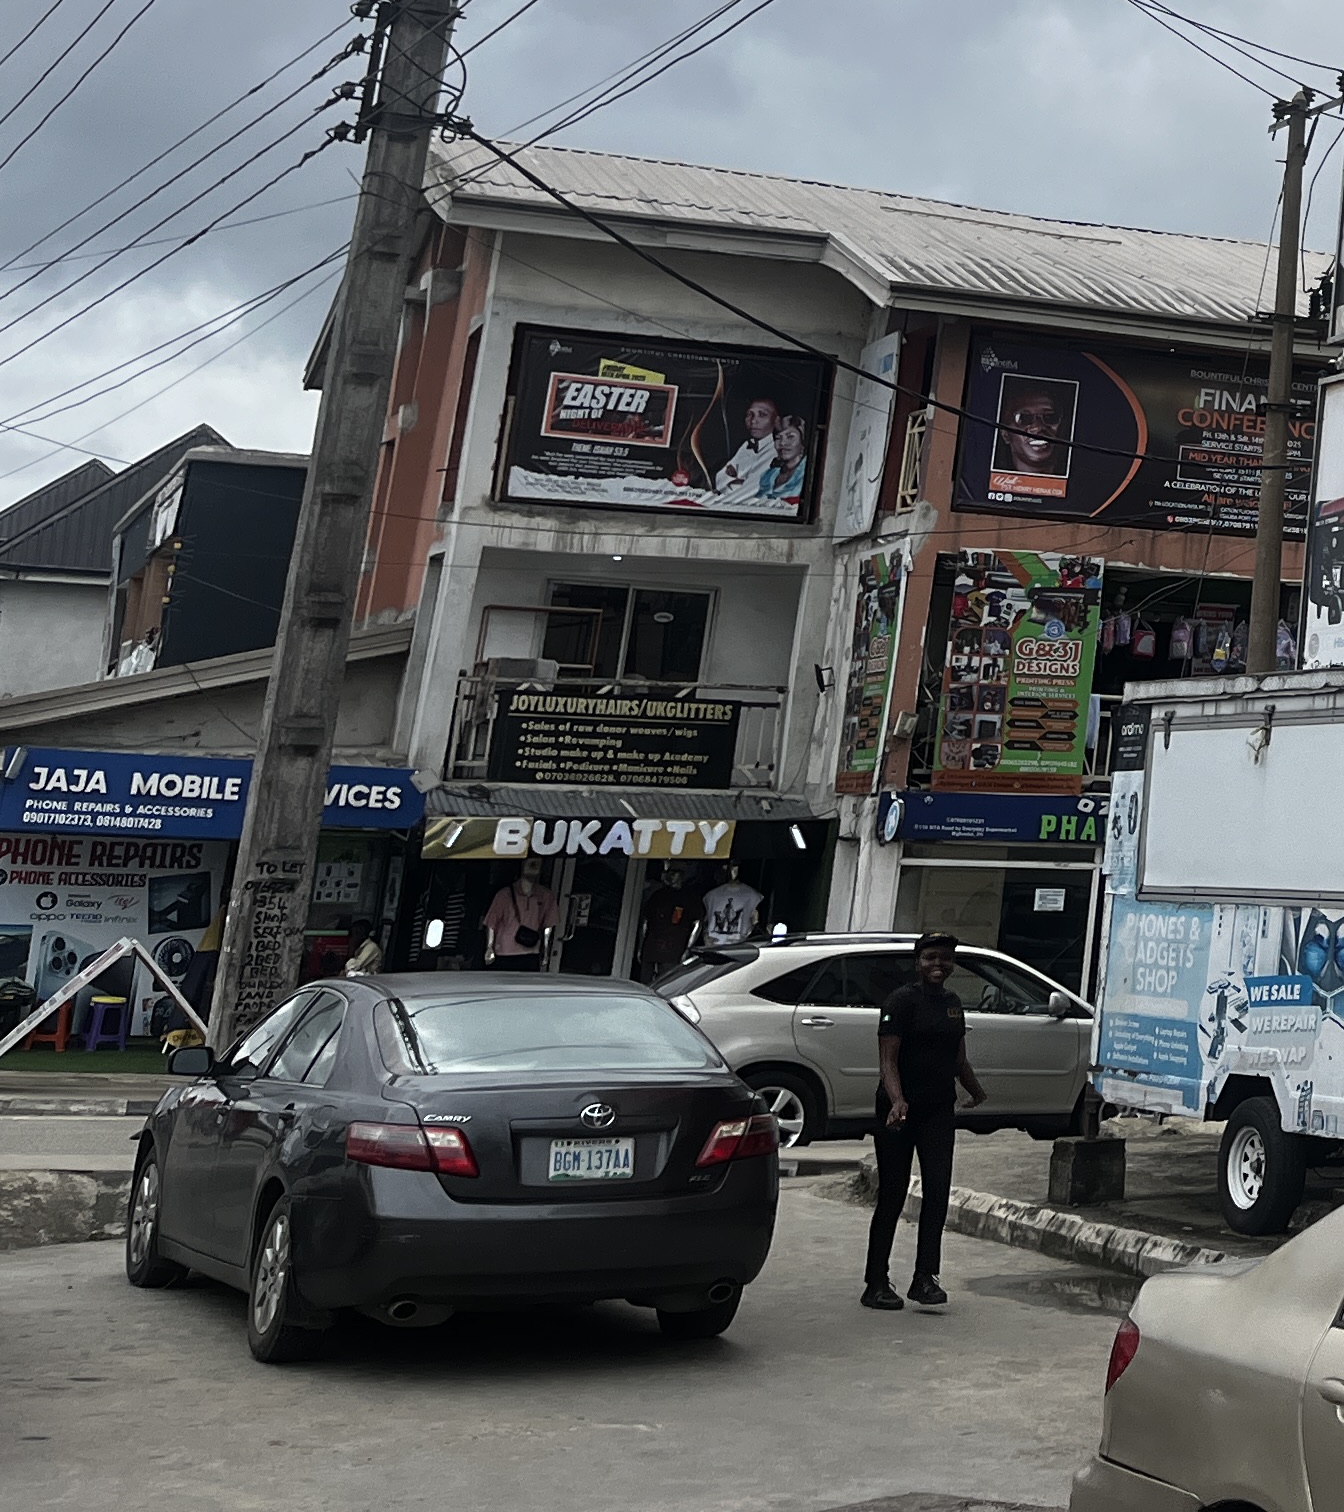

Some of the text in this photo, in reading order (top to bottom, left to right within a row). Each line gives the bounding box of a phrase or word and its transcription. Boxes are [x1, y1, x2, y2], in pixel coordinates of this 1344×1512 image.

[1190, 369, 1242, 383] BOUNTIFUL
[562, 382, 650, 414] EASTER
[559, 408, 590, 420] NIGHT
[1201, 440, 1263, 453] SERVICE STARTS
[1188, 451, 1236, 464] MID YEAR
[1225, 486, 1238, 495] OF
[1238, 487, 1254, 496] THE
[1016, 637, 1082, 663] G&3J
[1014, 658, 1080, 676] DESIGNS
[509, 694, 734, 720] JOYLUXURYHAIRS/UKGLITTERS
[528, 721, 556, 732] Sales
[558, 722, 571, 732] of
[572, 725, 594, 733] raw
[596, 723, 627, 734] donor
[526, 735, 623, 749] Salon Revamping
[523, 747, 709, 764] Studio make up & make up Academy
[565, 761, 610, 772] Pedicure
[618, 763, 665, 774] Manicure
[29, 766, 107, 794] JAJA
[129, 771, 243, 801] MOBILE
[25, 799, 213, 818] PHONE REPAIRS & ACCESSORIES
[492, 817, 730, 856] BUKATTY
[0, 837, 204, 869] PHONE REPAIRS
[255, 860, 307, 874] TO LET
[9, 870, 147, 888] PHONE ACCESSORIES
[65, 899, 103, 910] Galaxy
[1189, 915, 1201, 941] &
[255, 940, 281, 952] BED
[255, 953, 282, 966] BED
[1136, 967, 1178, 993] SHOP
[1250, 984, 1301, 1002] WE SALE
[1251, 1014, 1317, 1035] WE REPAIR
[423, 1113, 472, 1124] CAMRY
[554, 1147, 632, 1172] BGM-137AA
